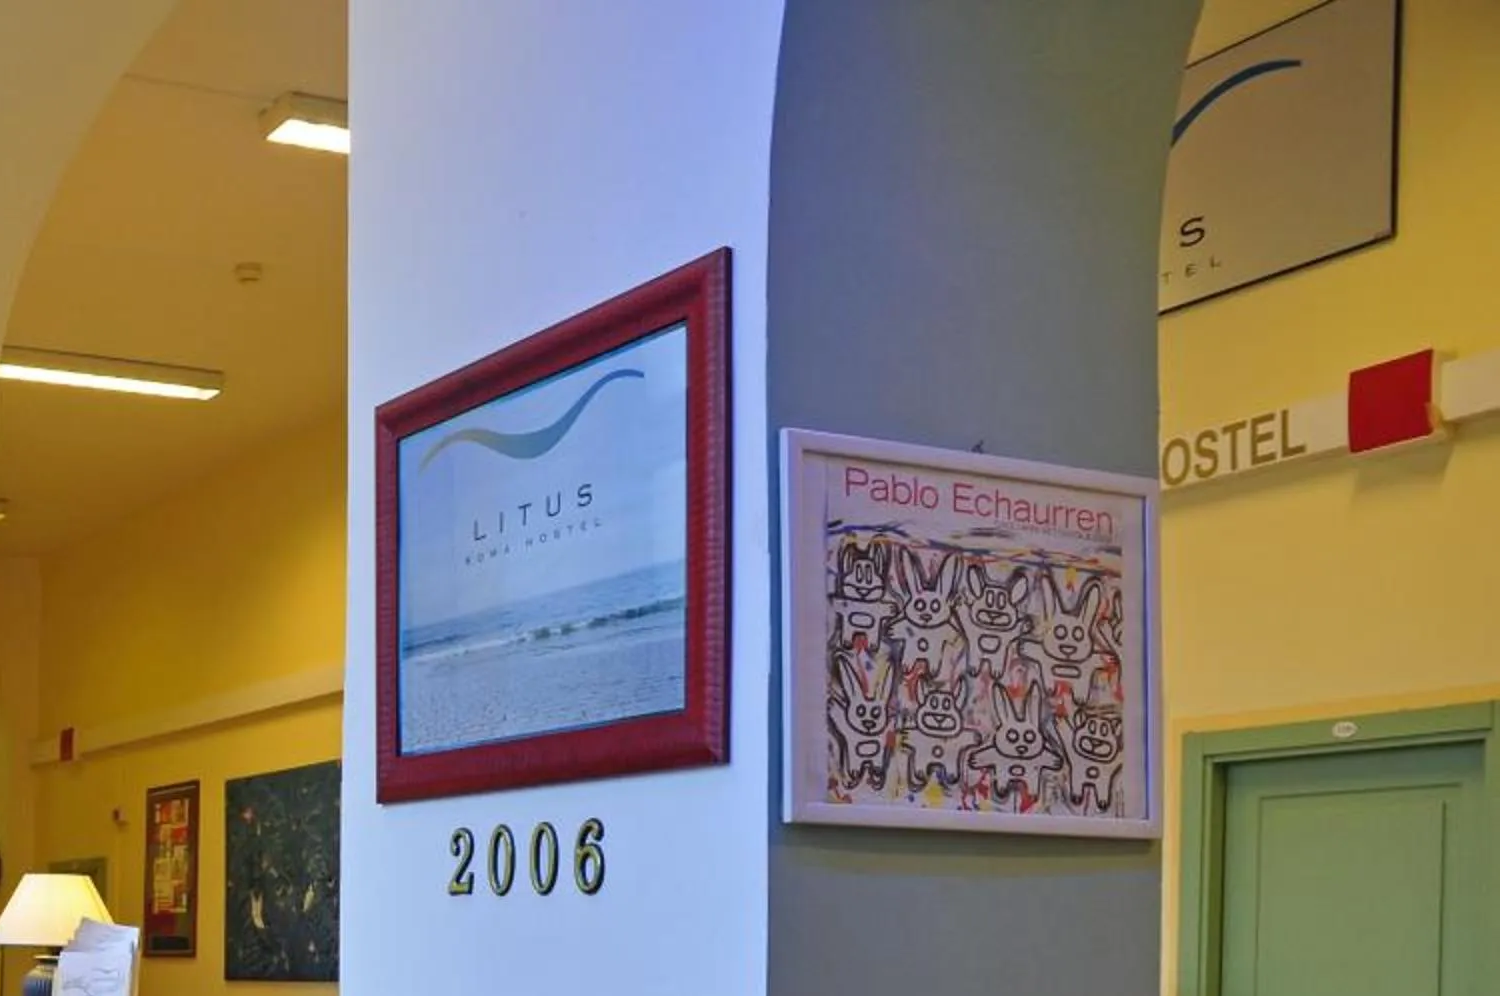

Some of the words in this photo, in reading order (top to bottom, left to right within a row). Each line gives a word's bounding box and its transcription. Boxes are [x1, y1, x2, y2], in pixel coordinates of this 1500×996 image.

[473, 483, 593, 541] LITUS
[844, 466, 939, 510] Pablo
[953, 482, 1114, 534] Echaurren
[525, 517, 602, 548] HOSTEL
[448, 817, 605, 896] 2006
